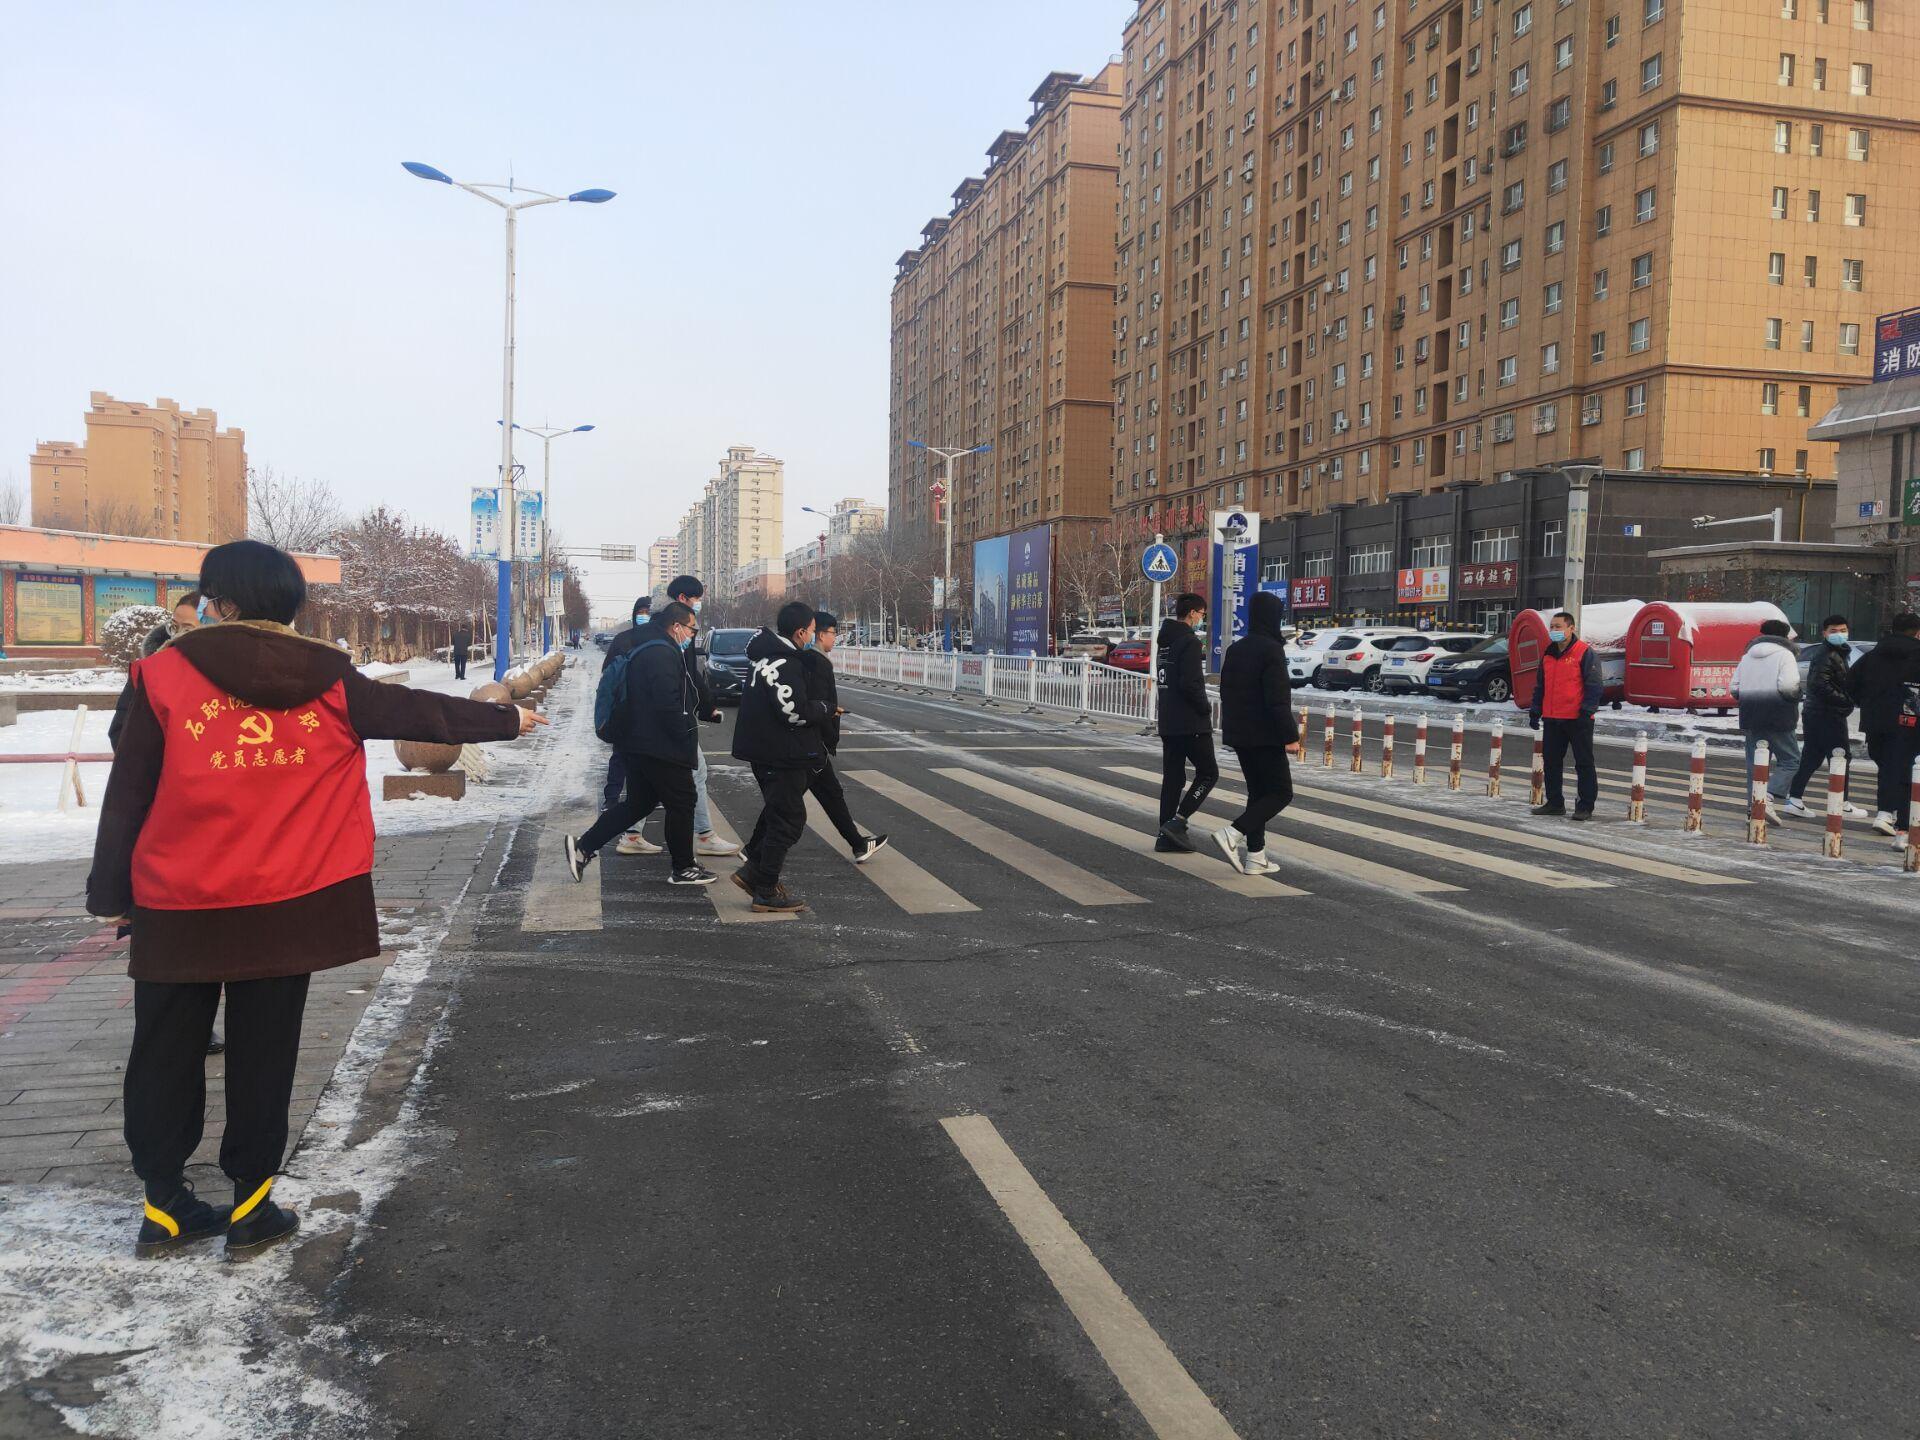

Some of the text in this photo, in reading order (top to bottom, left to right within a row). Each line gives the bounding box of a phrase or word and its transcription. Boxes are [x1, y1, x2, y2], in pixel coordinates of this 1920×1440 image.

[1293, 584, 1327, 603] 便利店
[209, 746, 307, 770] 党员志愿者
